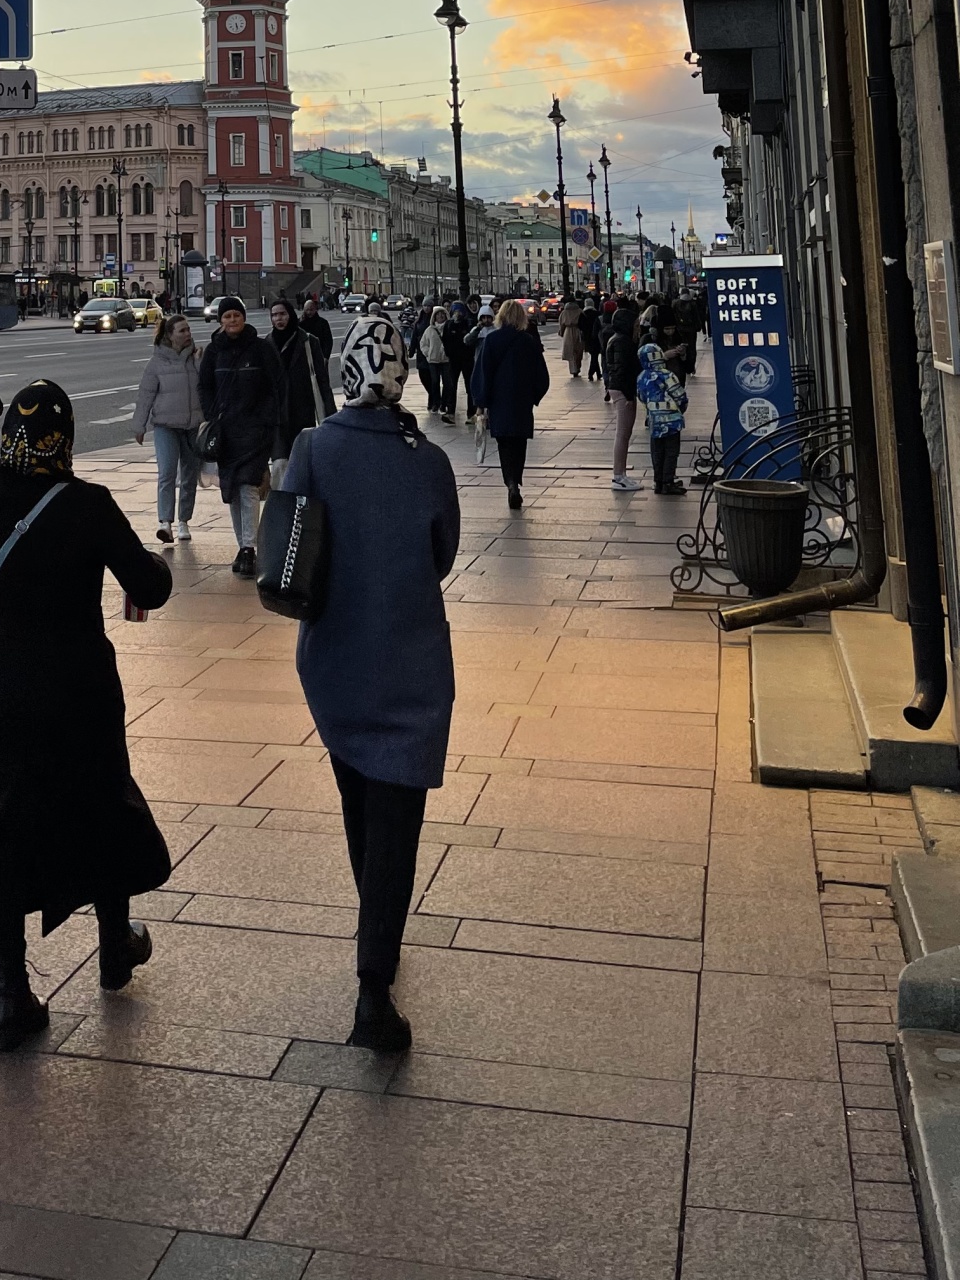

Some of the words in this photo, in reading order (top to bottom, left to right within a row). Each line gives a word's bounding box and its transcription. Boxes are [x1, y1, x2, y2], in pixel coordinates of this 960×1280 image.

[716, 278, 759, 291] BOFT
[717, 293, 778, 306] PRINTS
[719, 309, 763, 322] HERE
